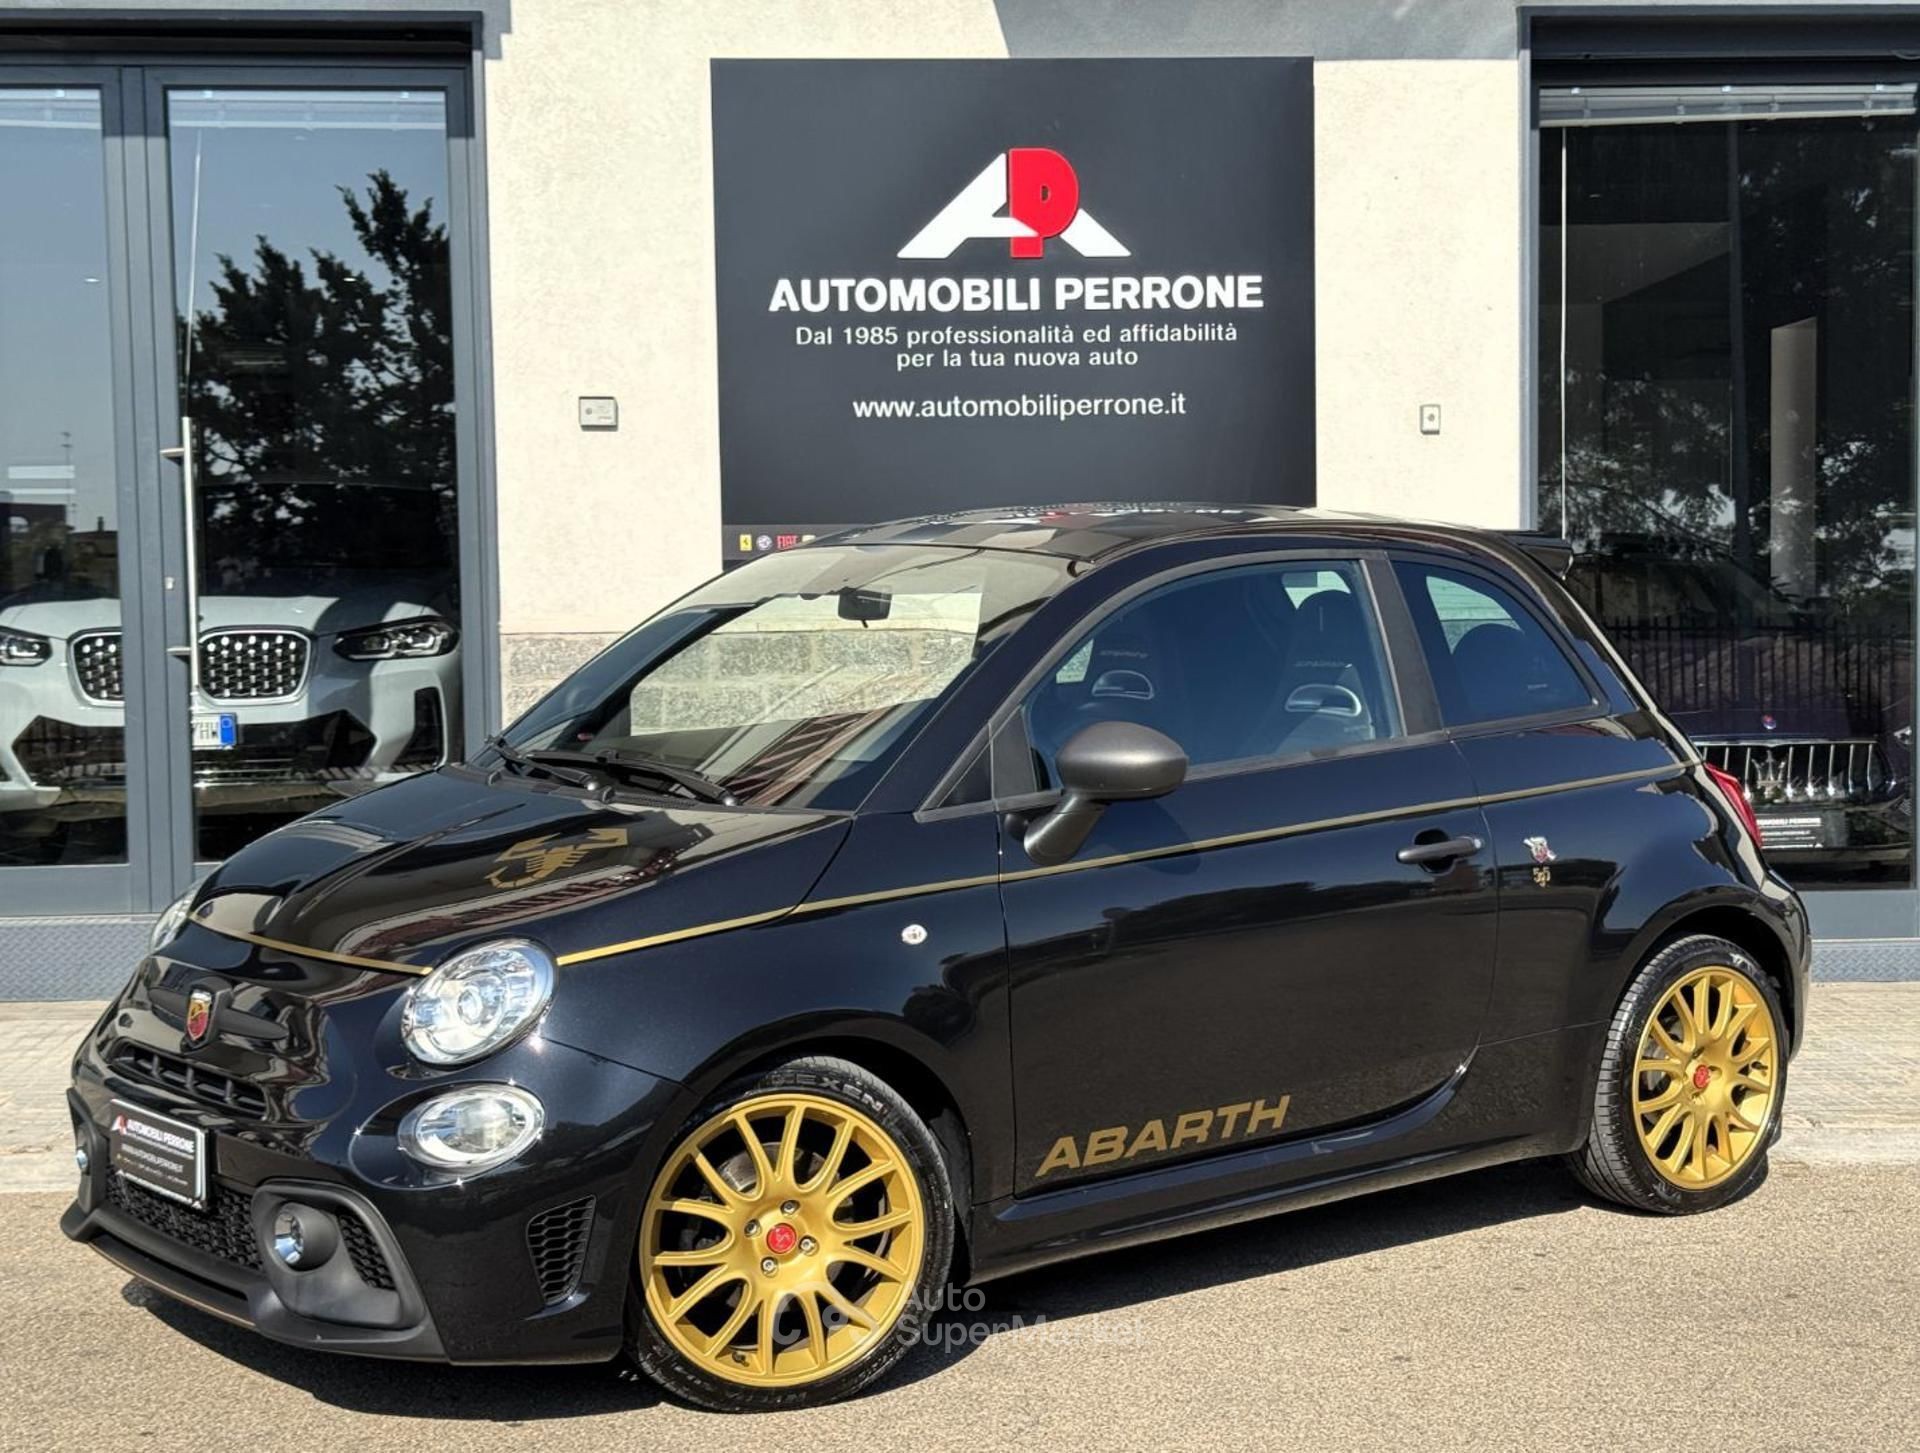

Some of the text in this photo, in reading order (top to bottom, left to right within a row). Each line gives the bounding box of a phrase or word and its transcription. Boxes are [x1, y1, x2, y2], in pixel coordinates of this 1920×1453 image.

[769, 275, 1264, 312] AUTOMOBILI PERRONE
[796, 322, 1237, 349] Dal 1985 professionalità ed affidabilità
[897, 348, 1138, 371] per la tua nuova auto
[852, 391, 1187, 422] www.automobiliperrone.it
[1035, 1095, 1291, 1177] ABARTH
